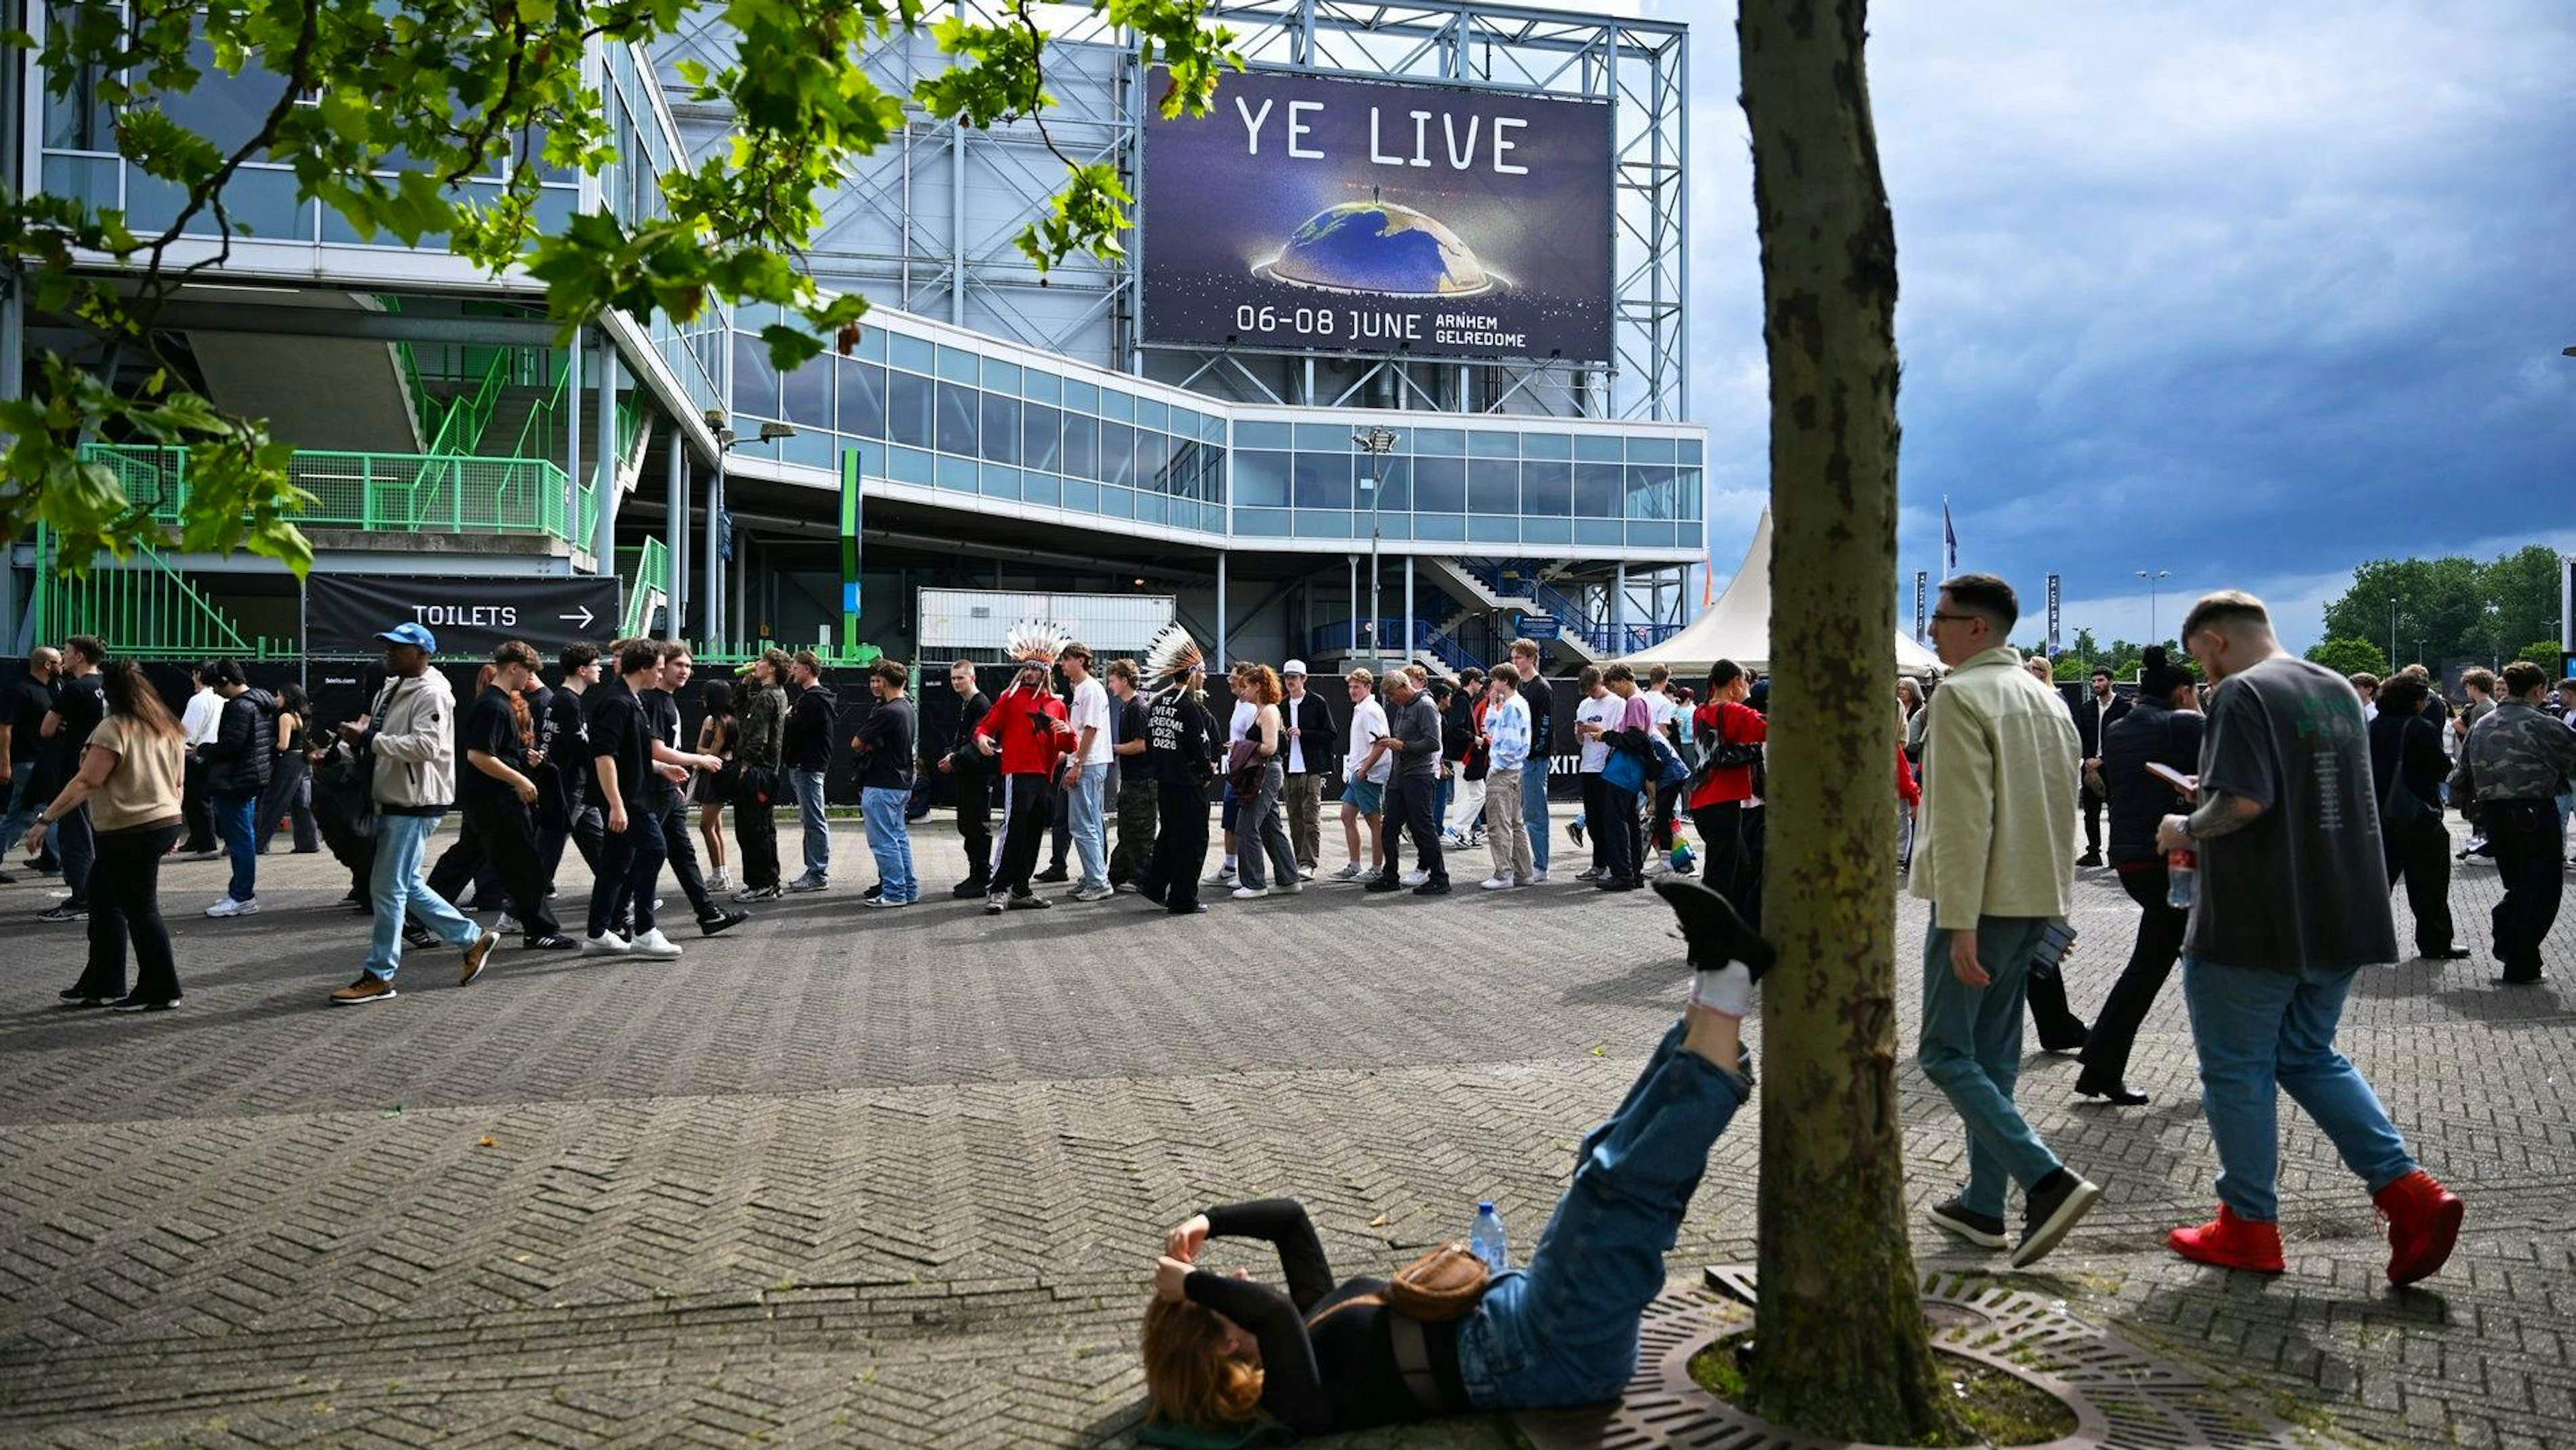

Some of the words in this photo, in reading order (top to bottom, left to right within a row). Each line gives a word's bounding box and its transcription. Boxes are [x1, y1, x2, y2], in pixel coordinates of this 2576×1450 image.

[1235, 95, 1326, 160] YE
[1370, 105, 1529, 175] LIVE
[1236, 305, 1334, 335] 06-08
[1348, 310, 1422, 340] JUNE
[1434, 313, 1499, 330] ARNHEM
[1435, 329, 1527, 348] GELREDOME
[411, 605, 517, 627] TOILETS
[1548, 754, 1580, 774] XIT
